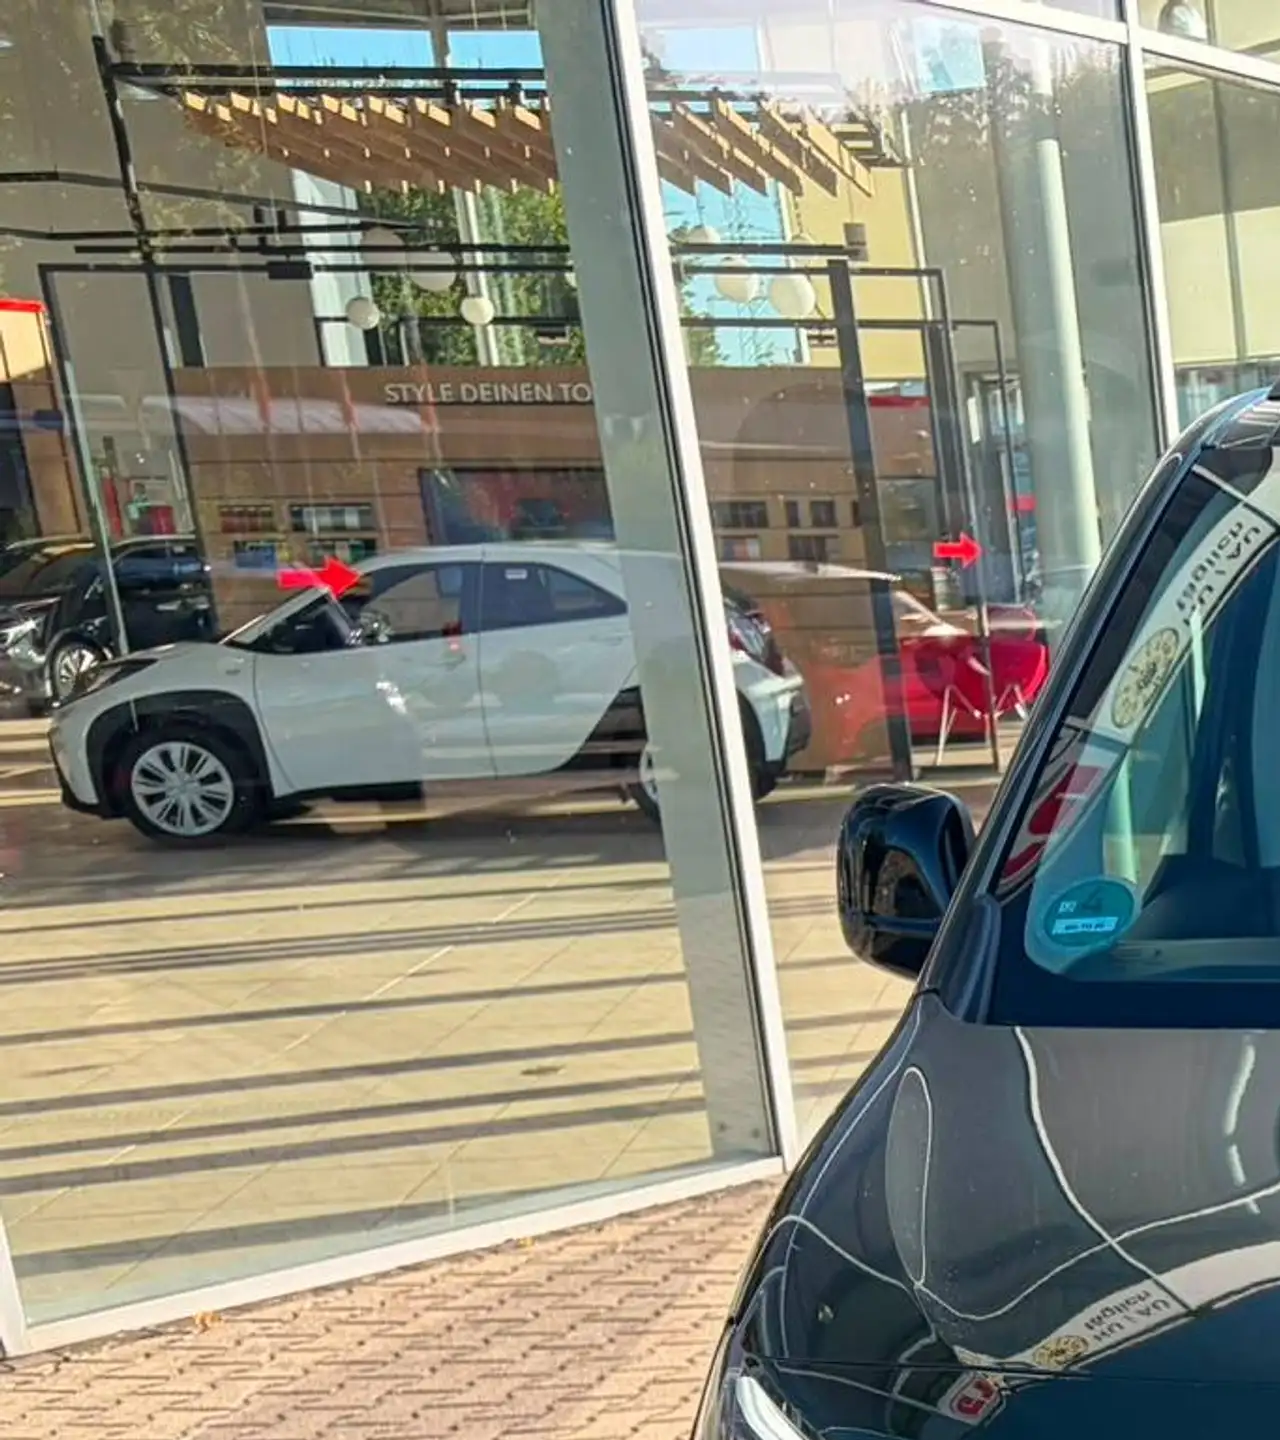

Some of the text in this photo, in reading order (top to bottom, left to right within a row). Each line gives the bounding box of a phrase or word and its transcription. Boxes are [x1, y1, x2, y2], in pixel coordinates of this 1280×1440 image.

[384, 382, 592, 403] STYLE DEINEN TO
